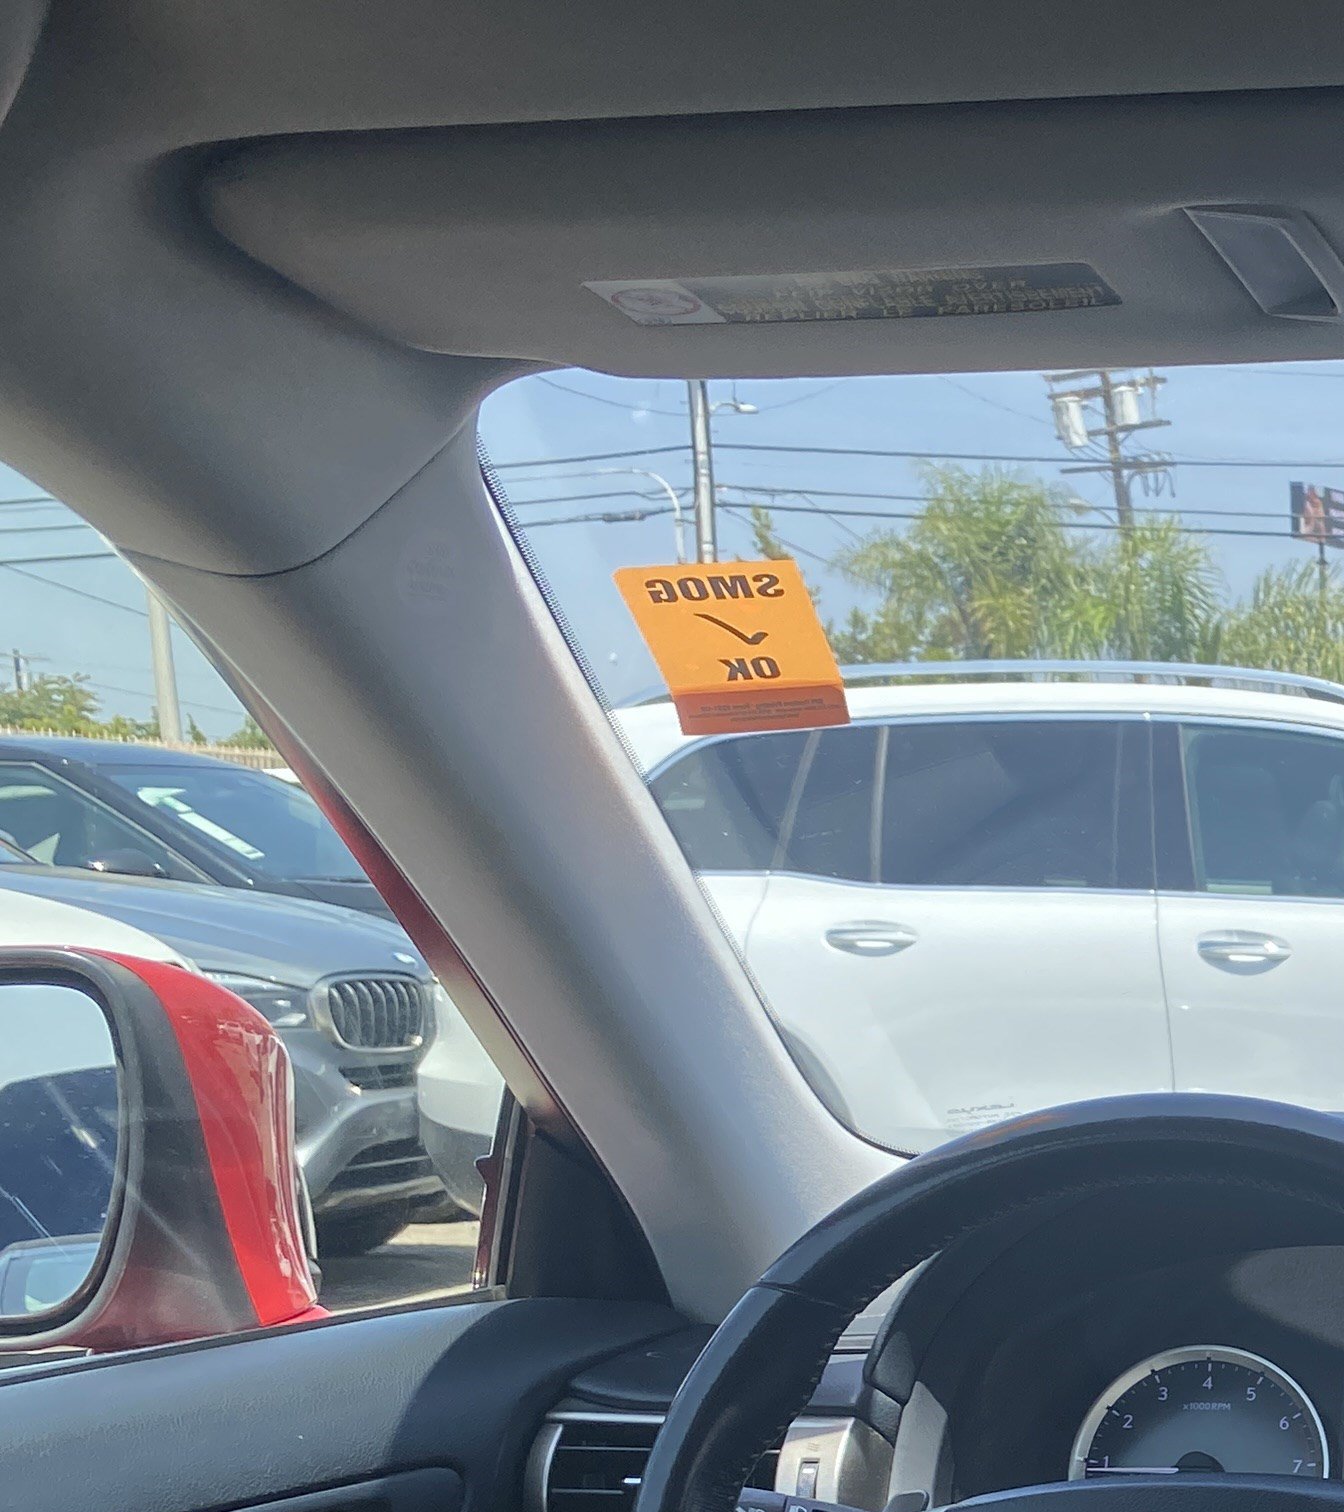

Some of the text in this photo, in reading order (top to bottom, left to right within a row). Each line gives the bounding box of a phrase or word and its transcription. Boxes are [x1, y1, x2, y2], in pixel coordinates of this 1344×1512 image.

[1202, 1376, 1213, 1390] 4
[1157, 1387, 1169, 1401] 3
[1246, 1387, 1257, 1401] 5
[1122, 1414, 1134, 1429] 2
[1279, 1416, 1290, 1430] 6
[1292, 1459, 1304, 1473] 7
